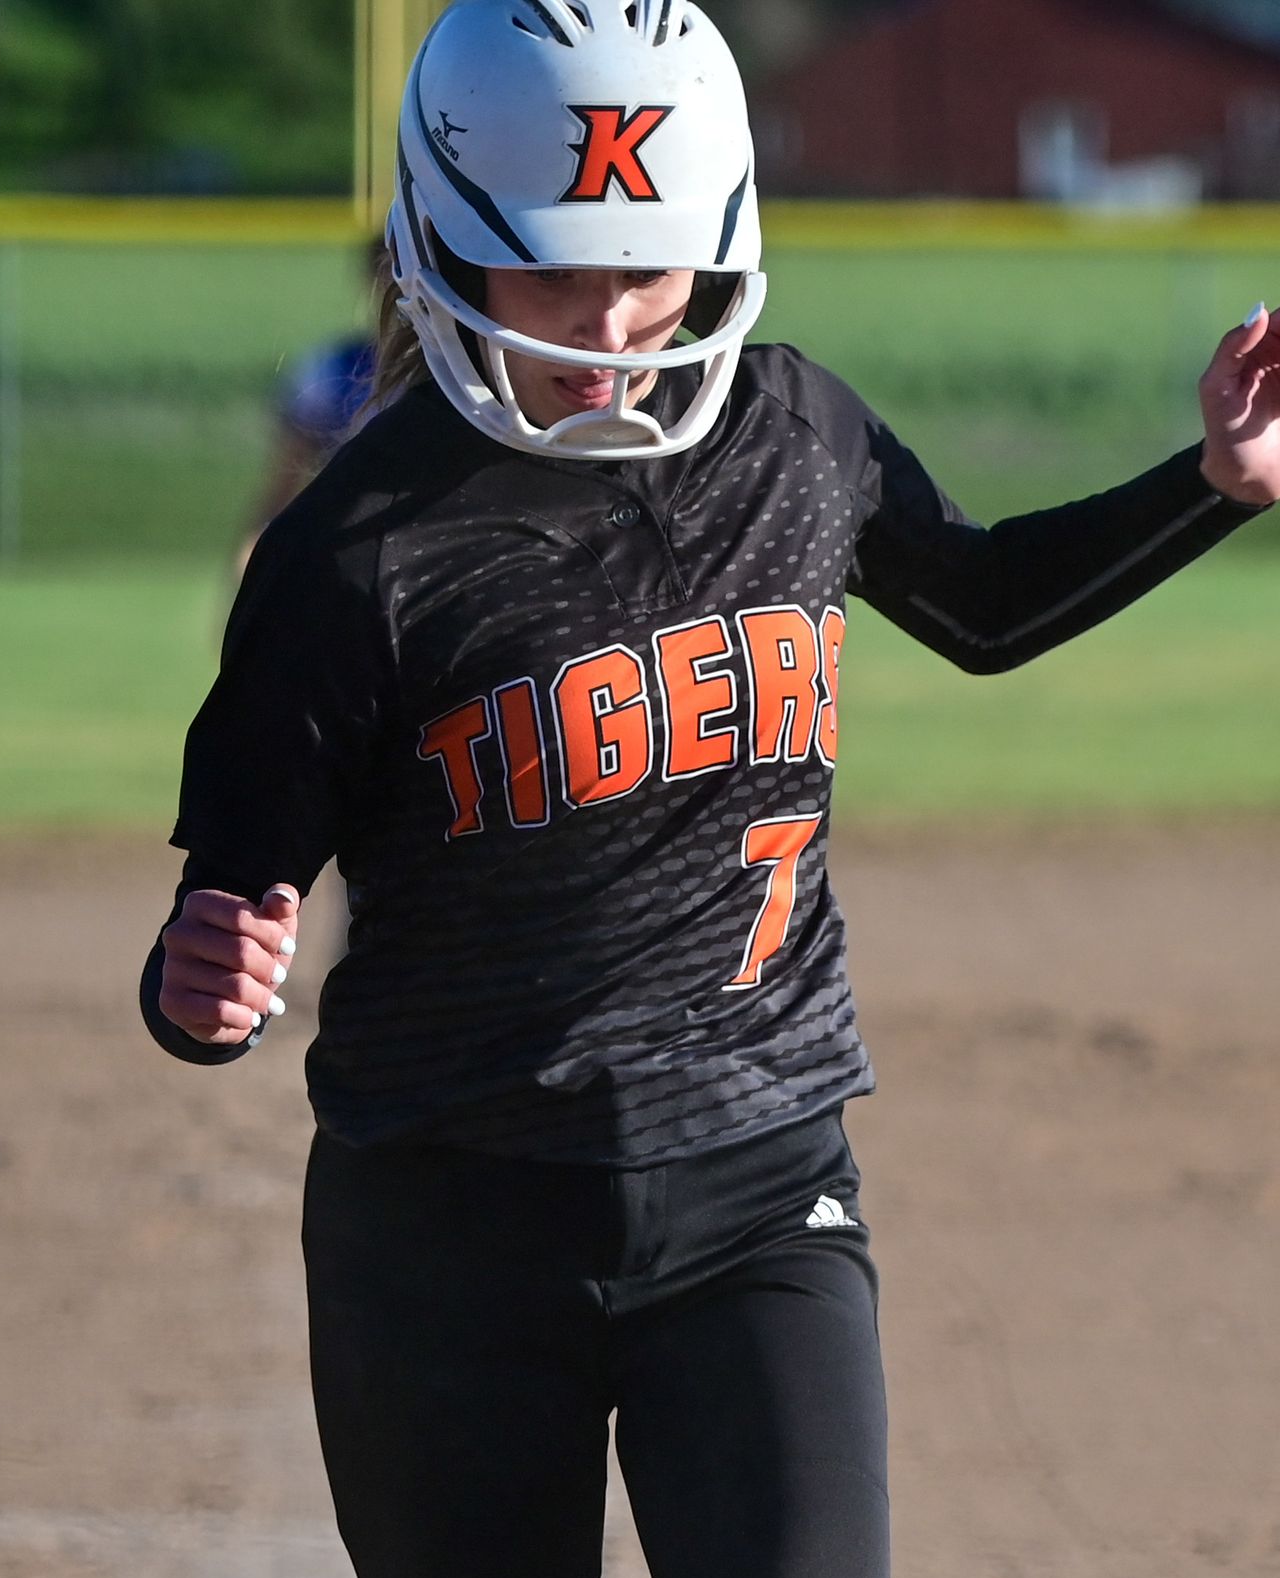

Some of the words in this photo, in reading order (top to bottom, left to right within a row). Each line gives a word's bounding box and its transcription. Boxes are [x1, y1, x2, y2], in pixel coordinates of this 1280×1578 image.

[557, 104, 676, 204] K
[417, 604, 846, 842] TIGERS
[721, 811, 823, 992] 7
